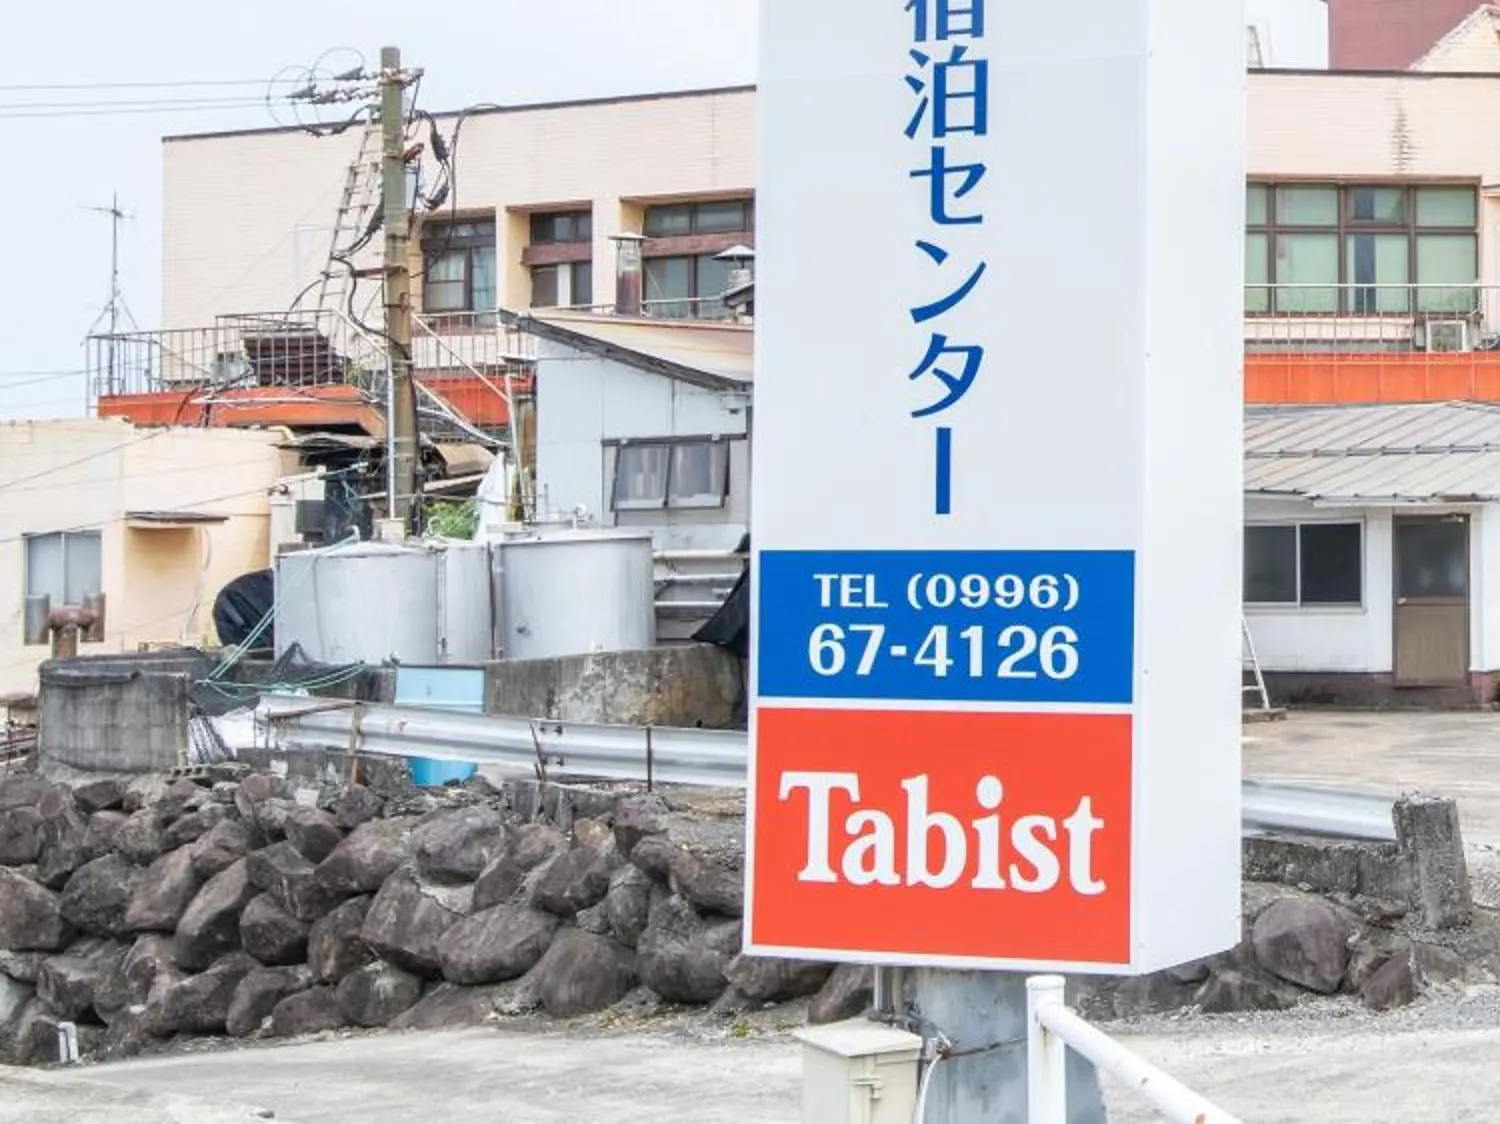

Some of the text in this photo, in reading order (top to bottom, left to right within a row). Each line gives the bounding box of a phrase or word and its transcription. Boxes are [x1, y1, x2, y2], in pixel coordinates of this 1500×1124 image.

[813, 573, 1080, 611] TEL (0996)
[808, 623, 1080, 680] 67-4126
[778, 771, 1107, 896] Tabist
